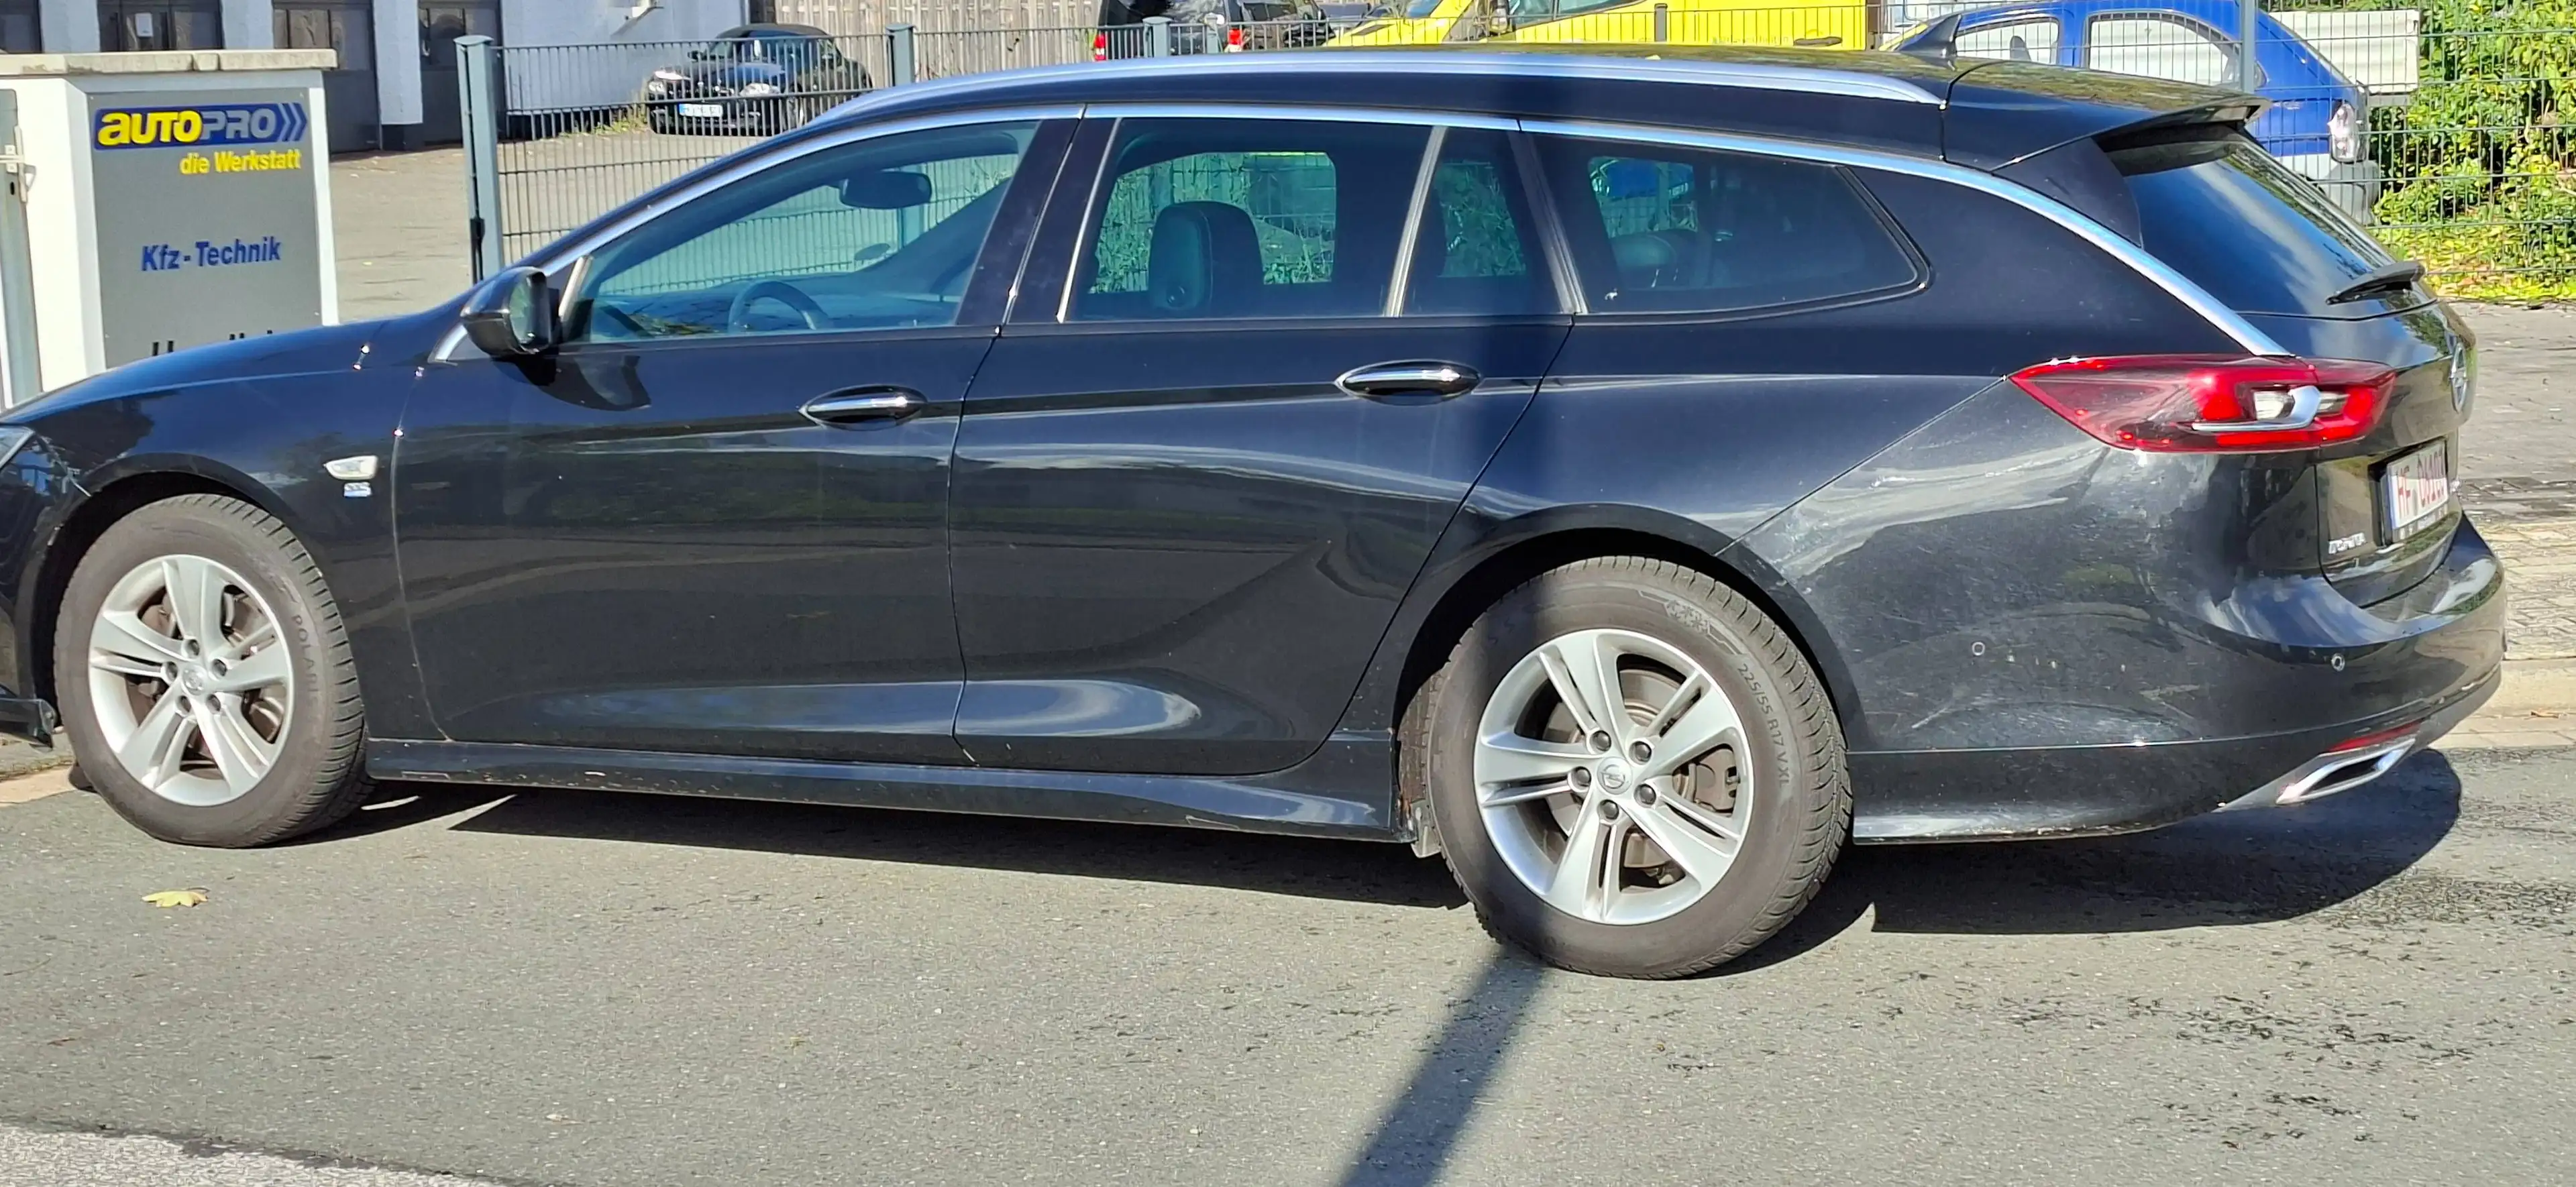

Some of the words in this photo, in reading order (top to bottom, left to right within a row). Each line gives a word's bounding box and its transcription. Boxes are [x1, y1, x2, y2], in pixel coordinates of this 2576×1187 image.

[179, 152, 210, 174] die
[214, 148, 302, 172] Werkstatt
[1737, 663, 1774, 715] 225/55
[1768, 718, 1784, 746] R17
